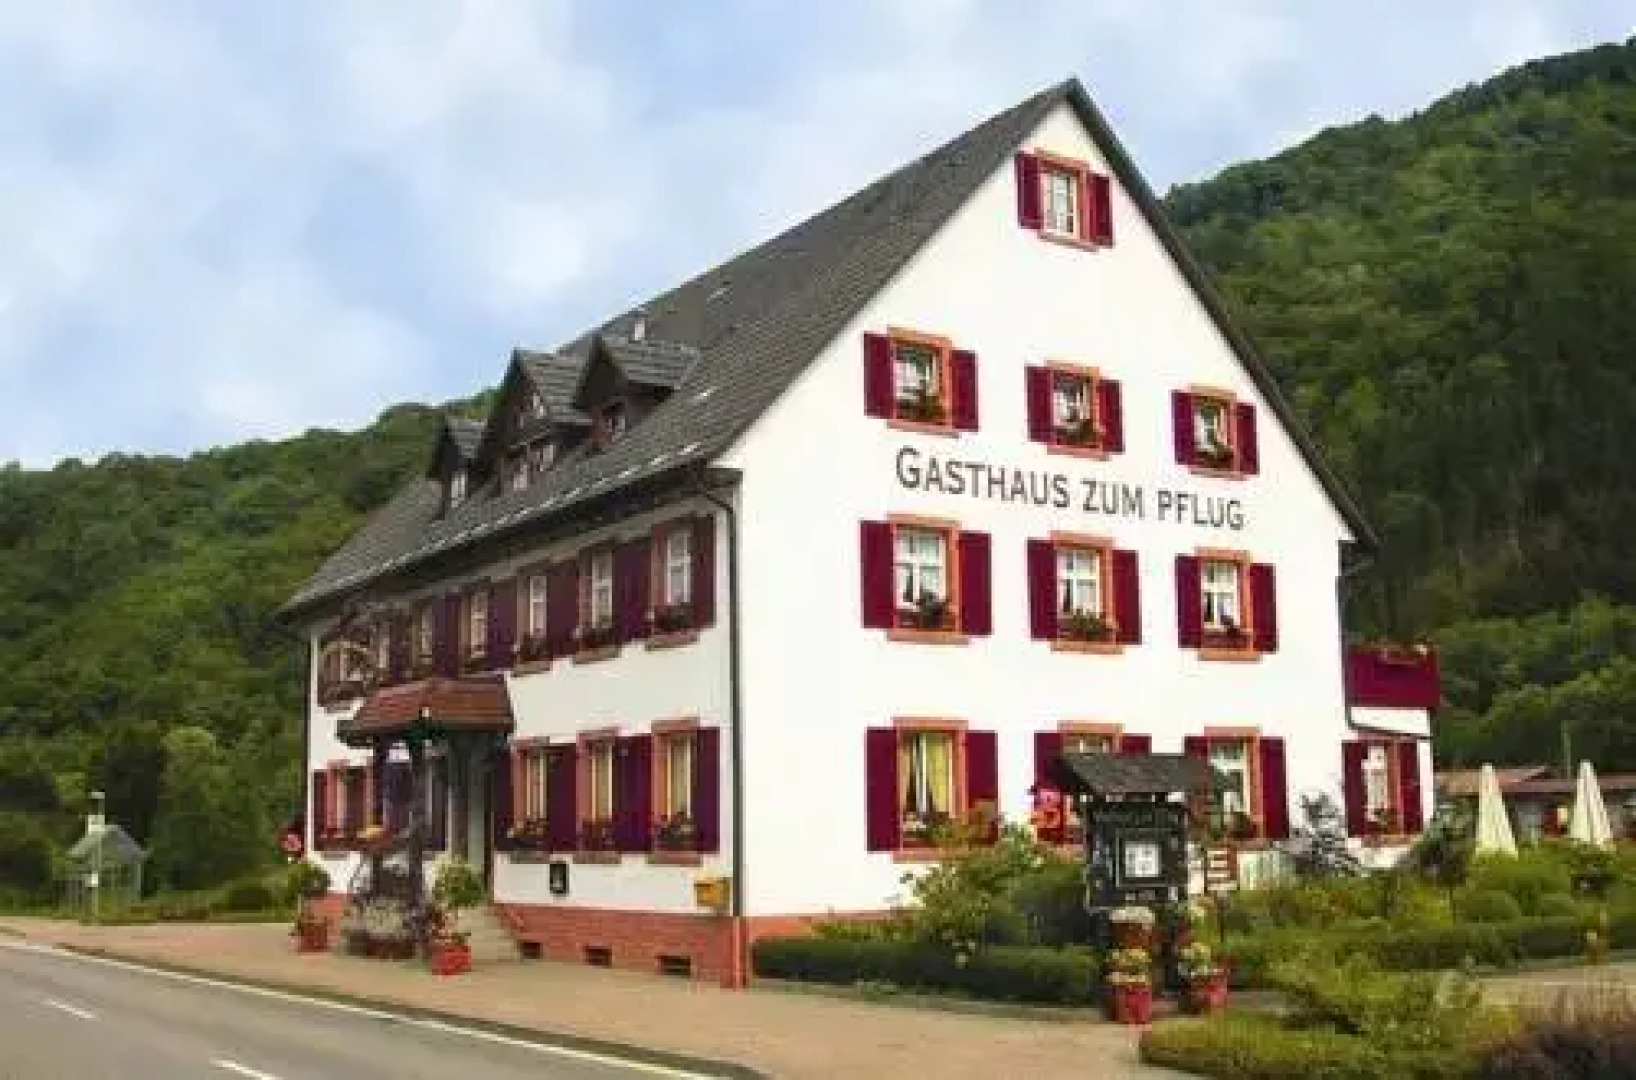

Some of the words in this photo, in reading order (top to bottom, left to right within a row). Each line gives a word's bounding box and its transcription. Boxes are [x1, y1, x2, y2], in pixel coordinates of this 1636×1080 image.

[896, 445, 1070, 509] GASTHAUS
[1081, 478, 1145, 520] ZUM
[1157, 489, 1245, 530] PFLUG
